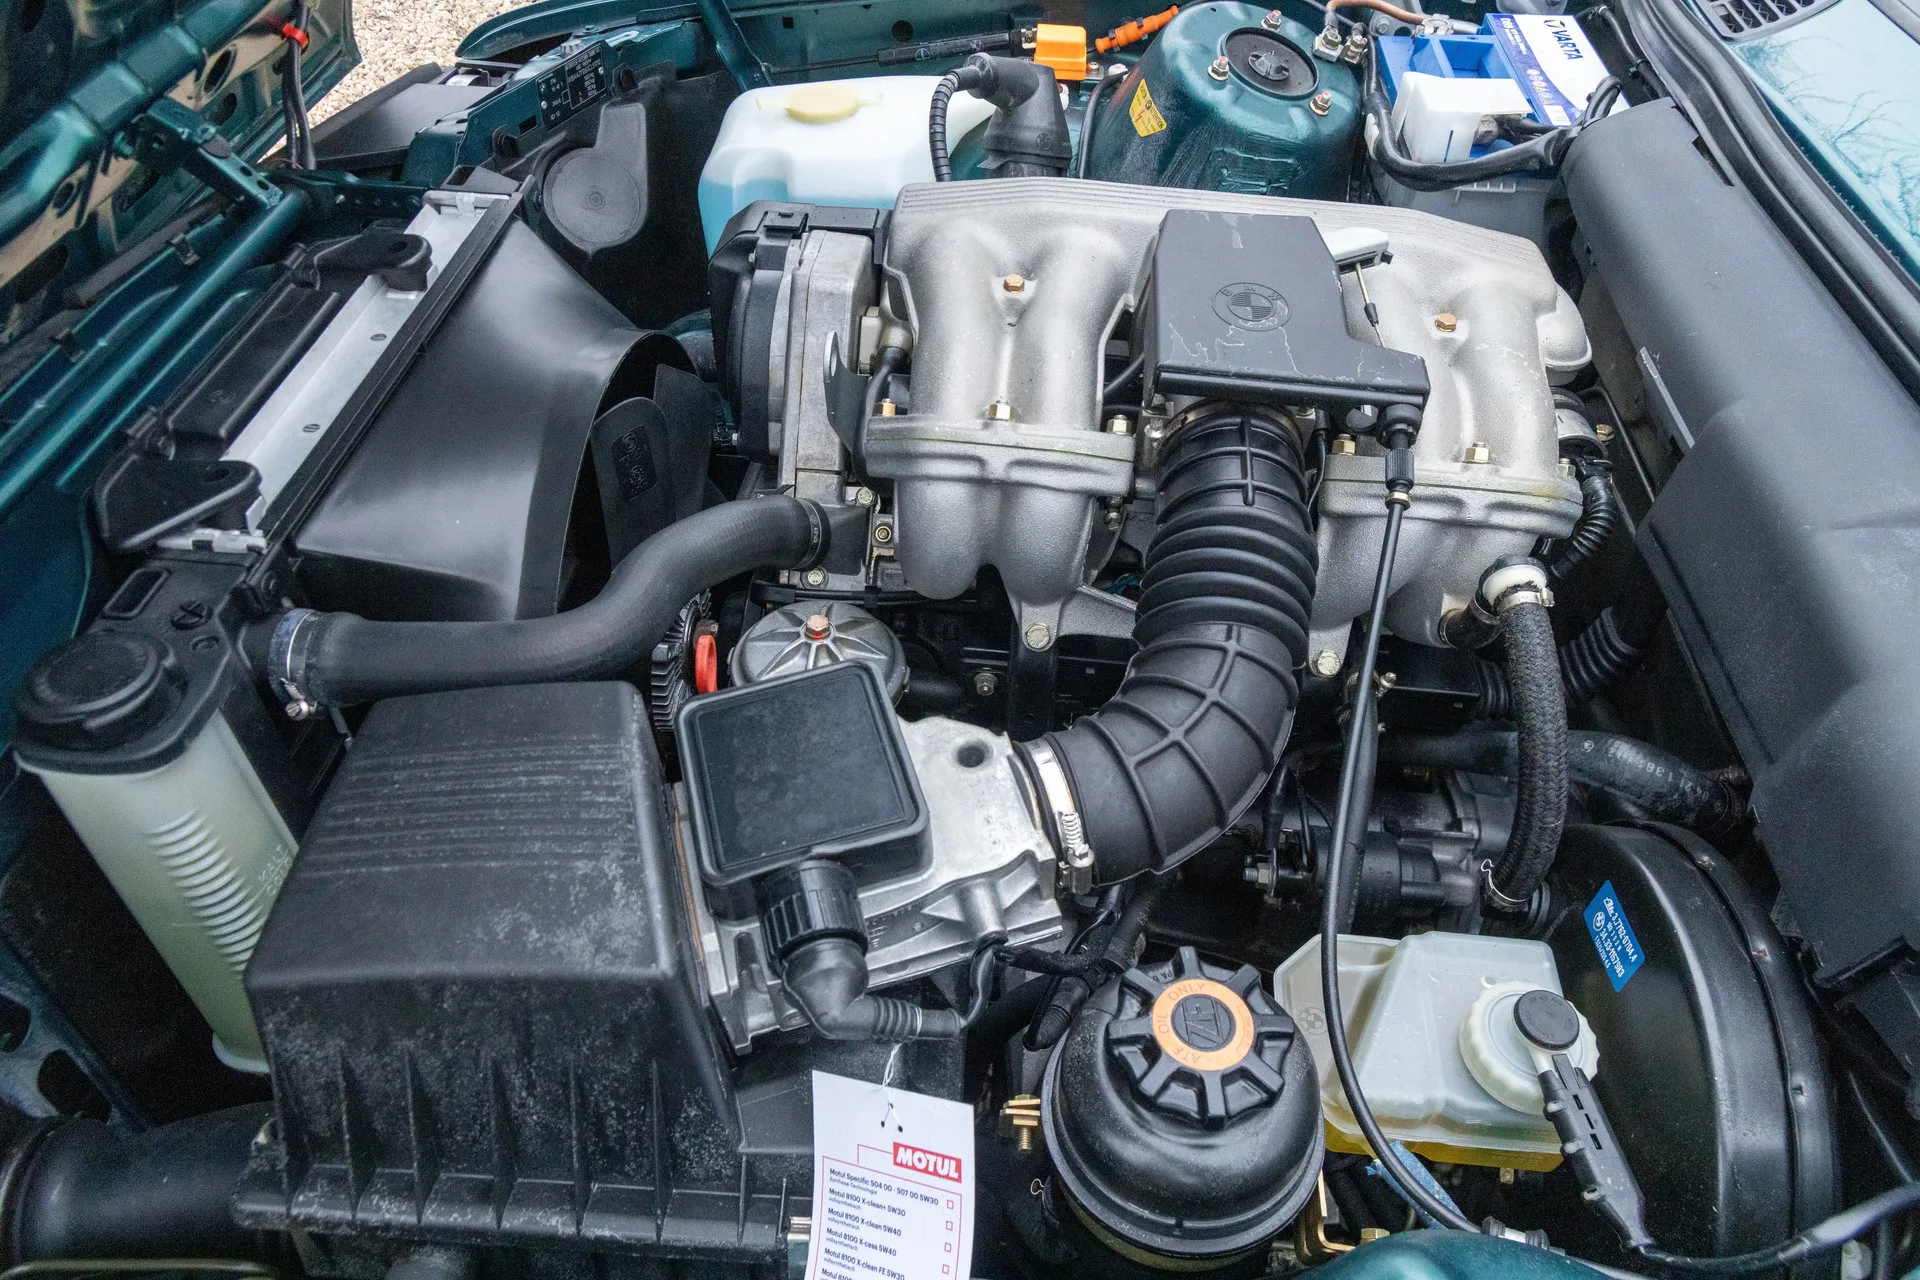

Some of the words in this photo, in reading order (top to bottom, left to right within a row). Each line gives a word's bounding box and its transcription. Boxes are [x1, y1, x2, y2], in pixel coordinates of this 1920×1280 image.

[1552, 30, 1584, 60] VARTA
[1168, 982, 1205, 1001] ONLY
[1156, 1012, 1169, 1034] OIL
[1171, 1046, 1202, 1064] ATF
[896, 1146, 959, 1179] MOTUL
[829, 1168, 846, 1178] Motul
[847, 1173, 870, 1186] Specific
[871, 1180, 882, 1189] 504
[884, 1183, 893, 1192] 00
[897, 1187, 908, 1197] 507
[910, 1191, 919, 1200] 00
[920, 1193, 939, 1206] 5W30
[829, 1188, 845, 1198] Motul
[846, 1192, 861, 1203] 8100
[862, 1197, 886, 1209] X-clean+
[887, 1205, 906, 1217] 5W30
[828, 1207, 844, 1218] Motul
[845, 1212, 860, 1223] 8100
[861, 1218, 882, 1230] X-clean
[883, 1225, 902, 1237] 5W40
[827, 1227, 843, 1239] Motul
[844, 1232, 858, 1243] 8100
[859, 1238, 878, 1251] X-cess
[879, 1244, 897, 1257] 5W40
[822, 1268, 838, 1280] Motul
[825, 1248, 840, 1259] Motul
[841, 1253, 856, 1264] 8100
[857, 1259, 878, 1272] X-clean
[879, 1266, 886, 1275] FE
[887, 1270, 905, 1280] 5W30
